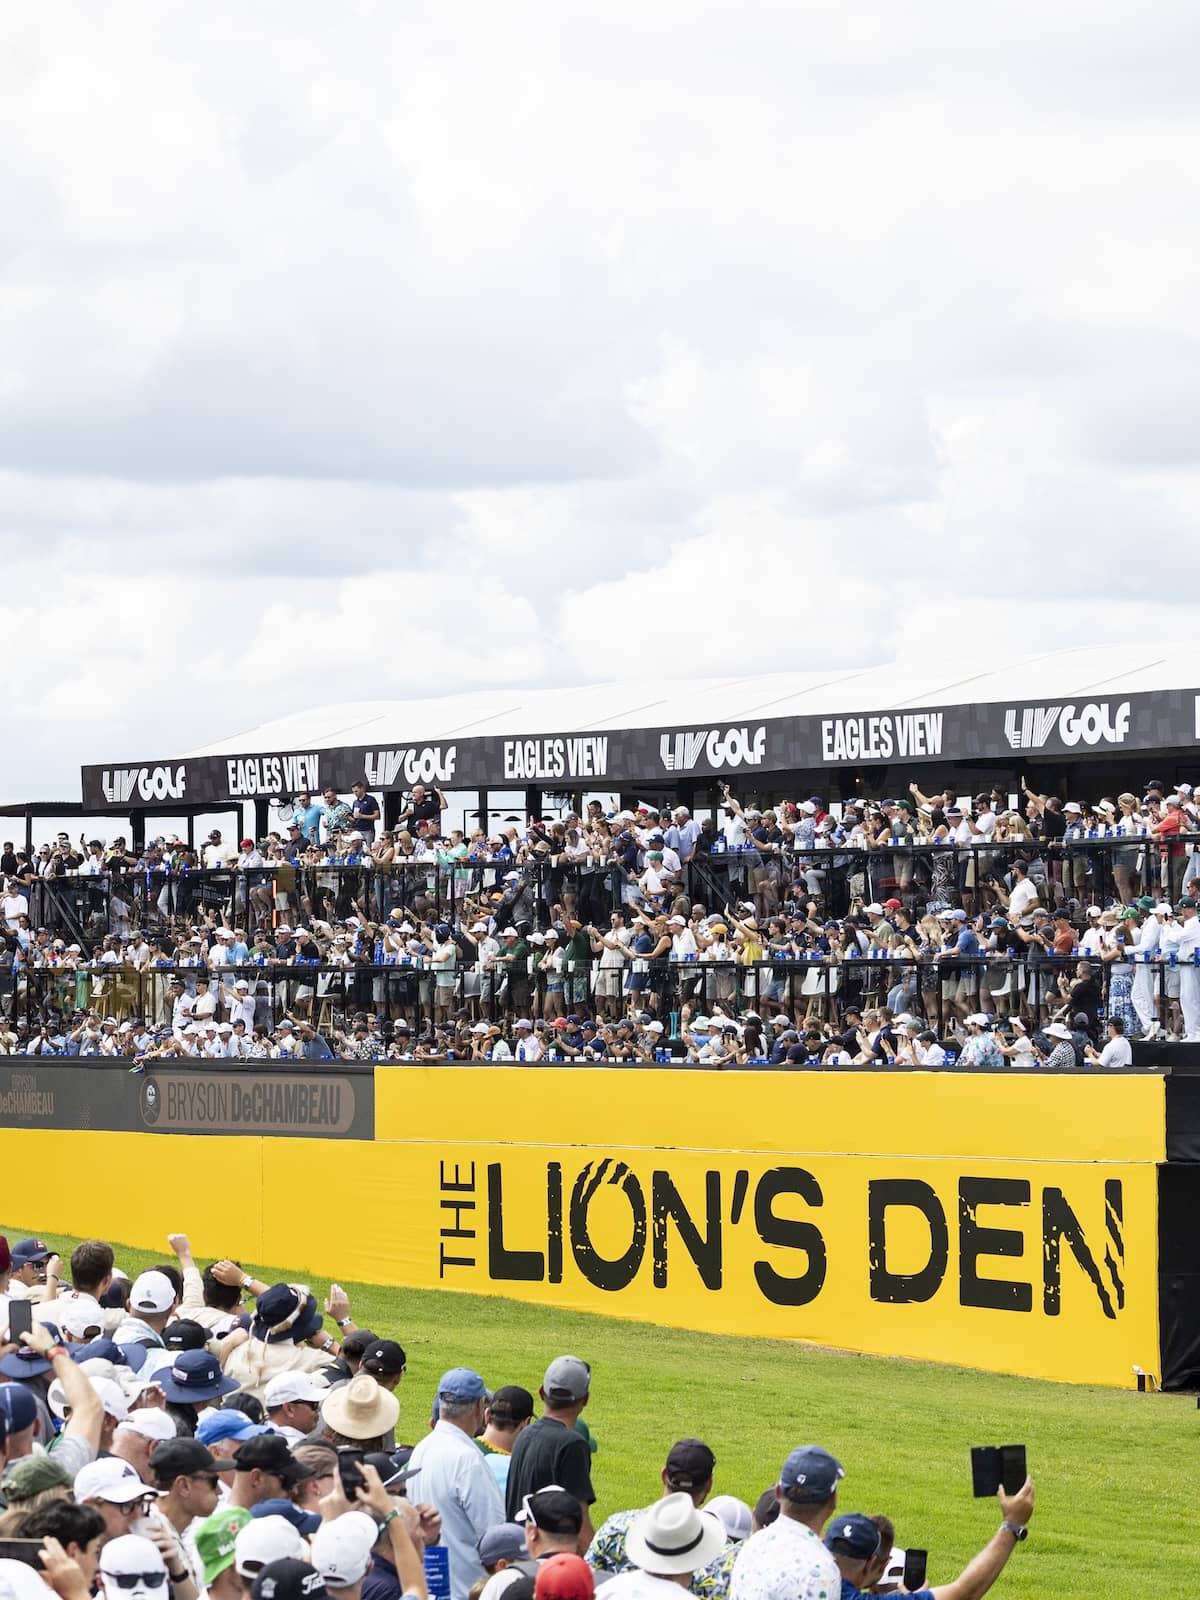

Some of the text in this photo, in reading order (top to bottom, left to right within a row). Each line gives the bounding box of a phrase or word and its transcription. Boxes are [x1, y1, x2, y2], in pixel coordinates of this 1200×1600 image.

[504, 736, 609, 780] EAGLES VIEW
[821, 713, 944, 761] EAGLES VIEW
[227, 754, 320, 795] EAGLES VIEW
[167, 1082, 340, 1125] BRYSON DeCHAMBEAU
[440, 1158, 1125, 1320] THE LION'S DEN
